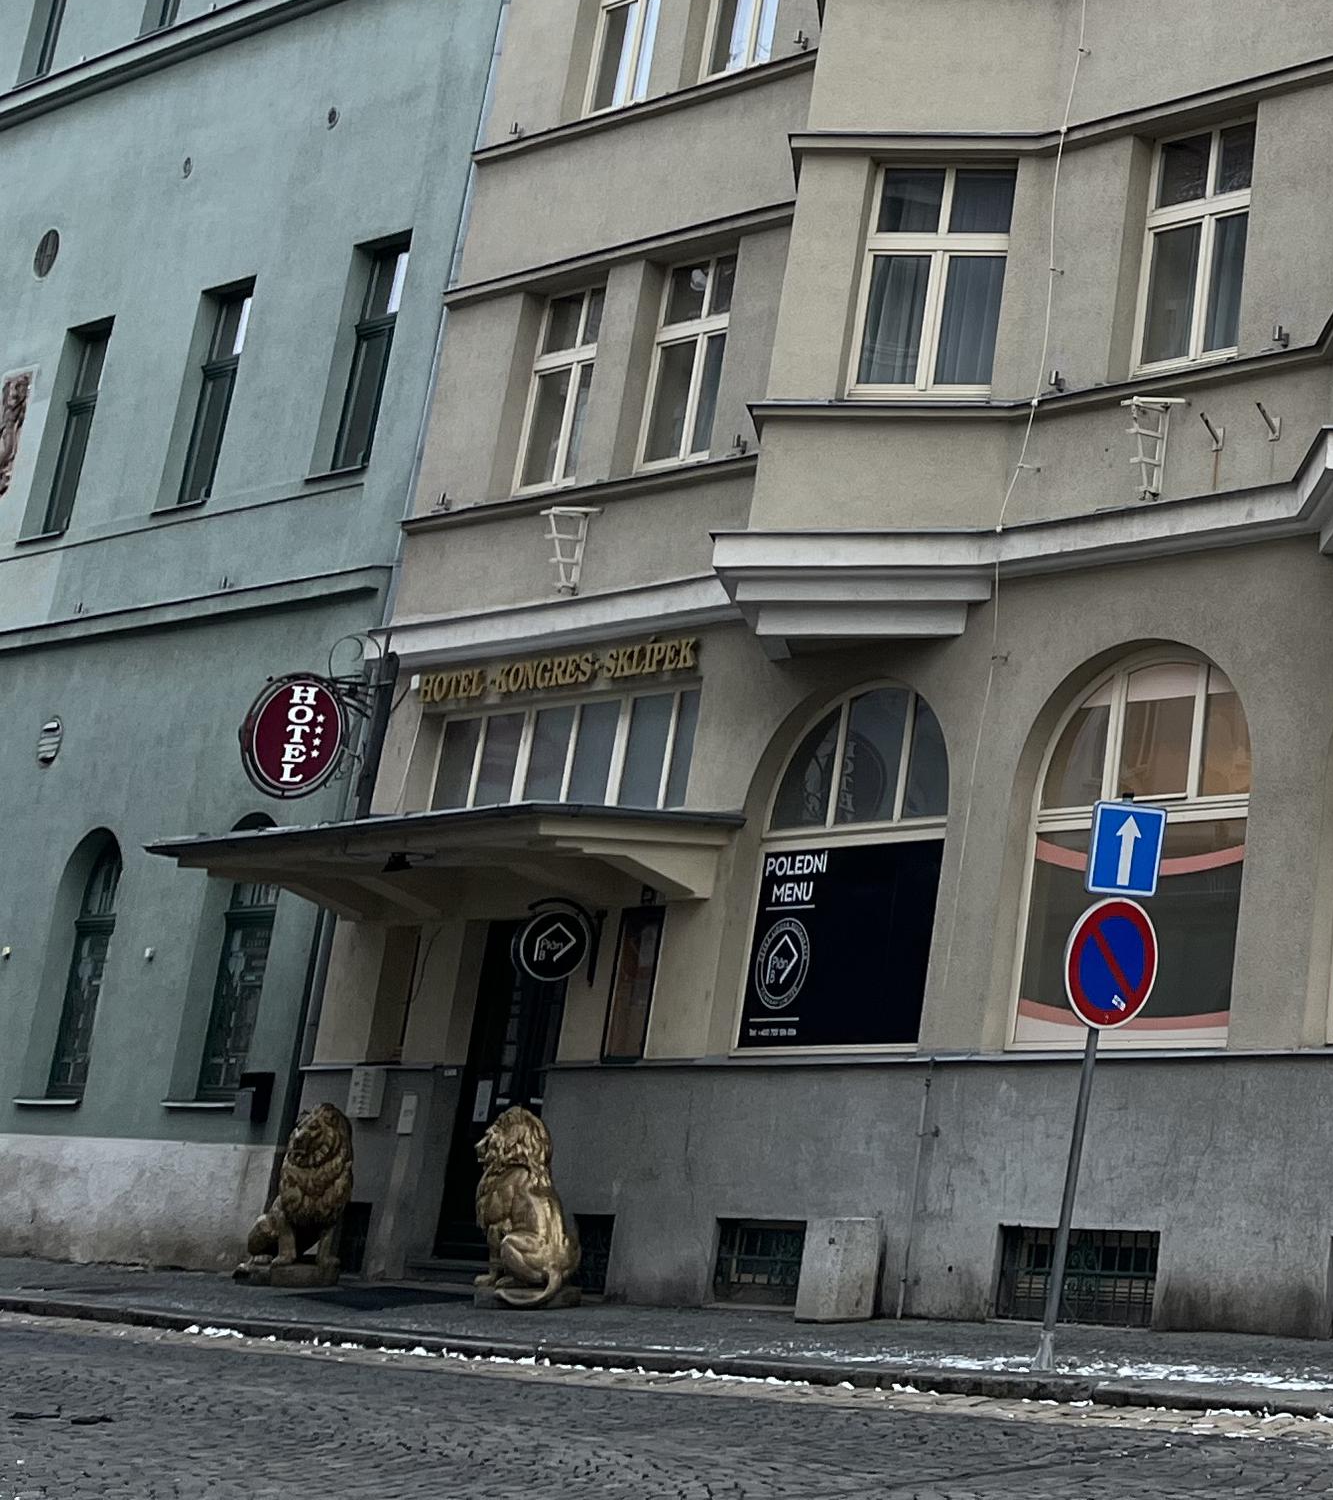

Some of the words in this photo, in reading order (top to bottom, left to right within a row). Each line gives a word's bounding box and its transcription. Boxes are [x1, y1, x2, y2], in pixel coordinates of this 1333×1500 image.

[420, 668, 484, 702] HOTEL
[279, 685, 319, 782] HOTEL
[765, 850, 828, 877] POLEDNÍ
[771, 881, 813, 903] MENU
